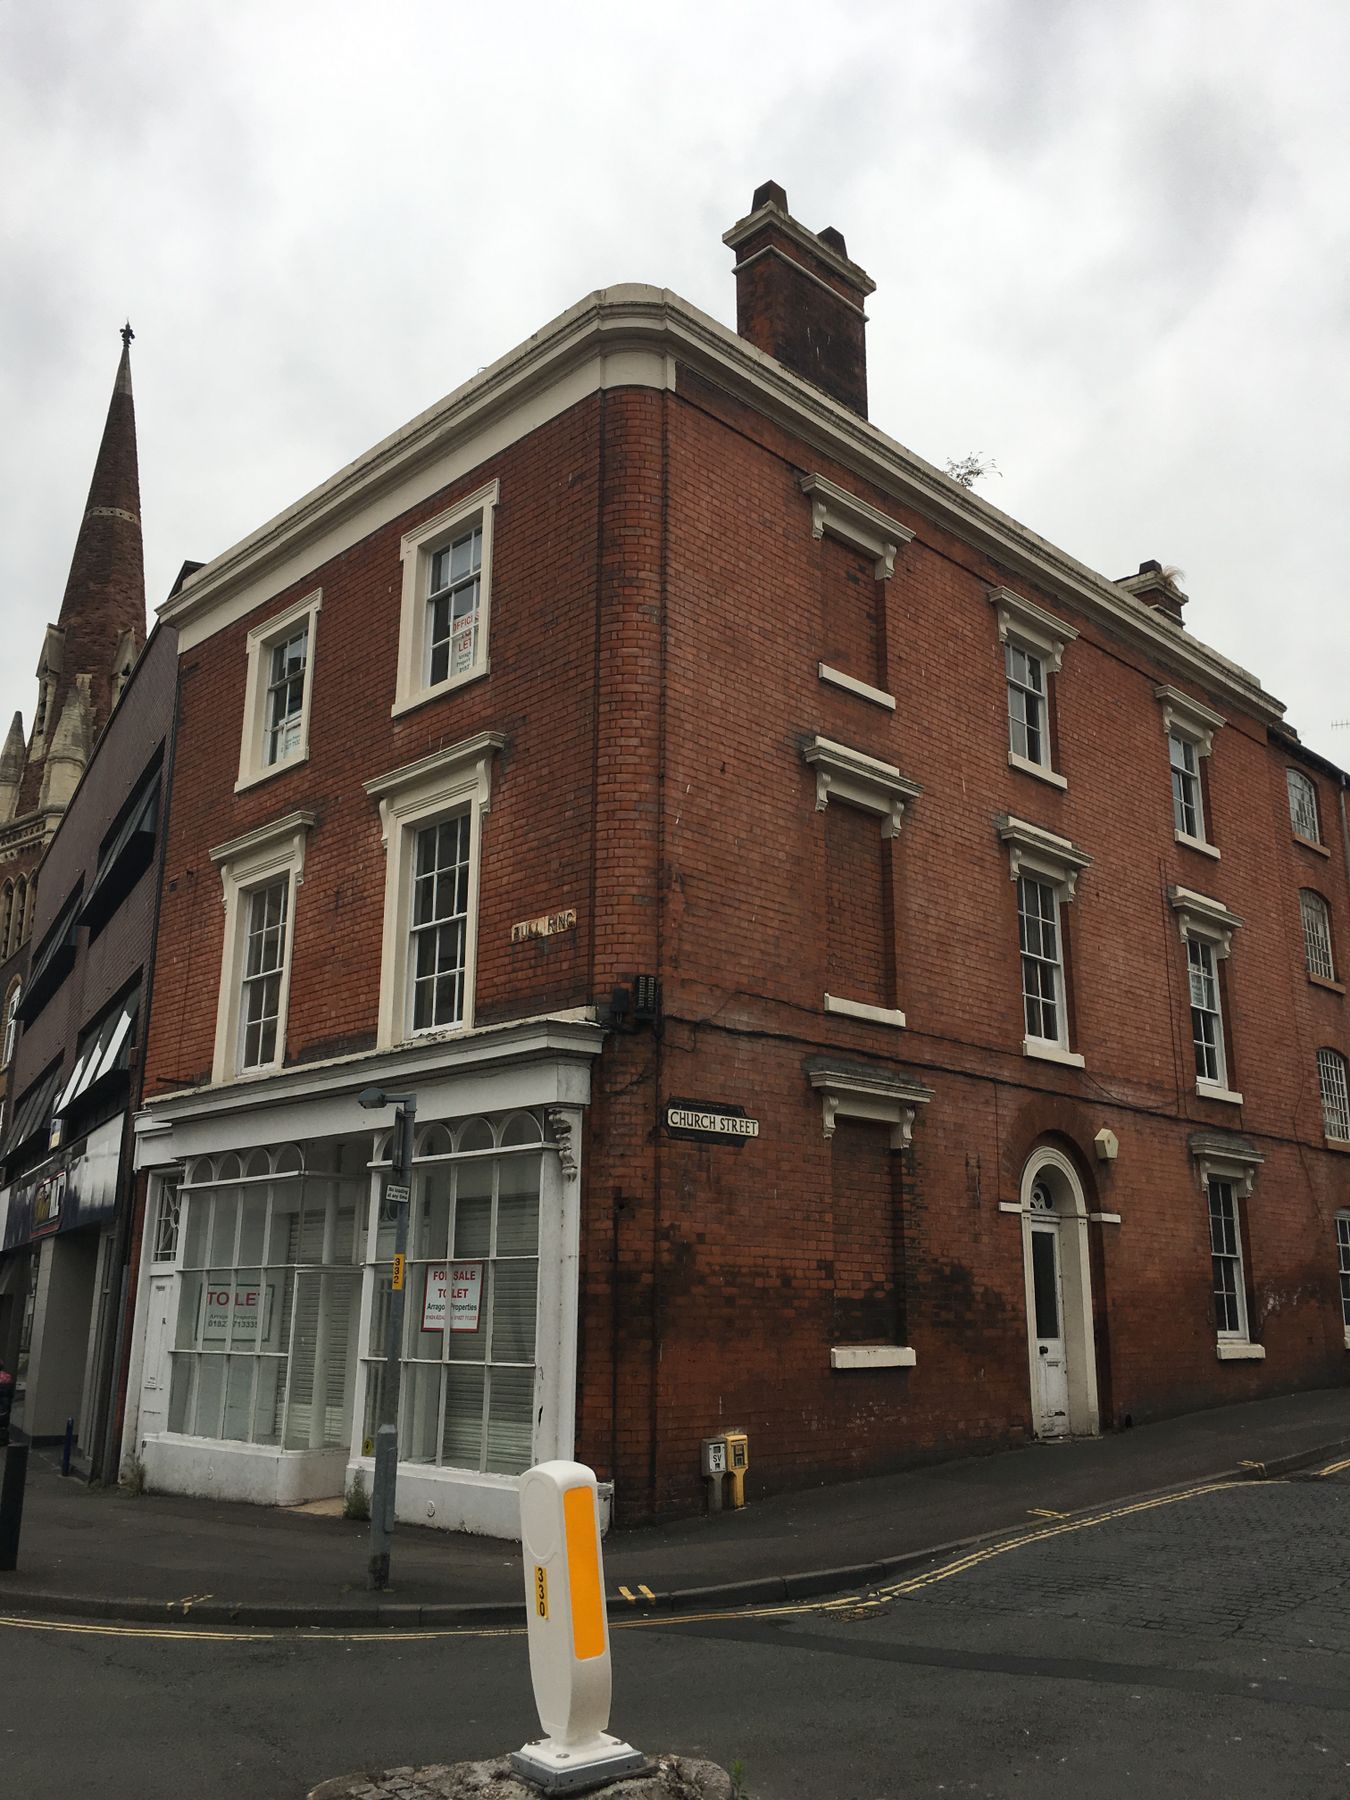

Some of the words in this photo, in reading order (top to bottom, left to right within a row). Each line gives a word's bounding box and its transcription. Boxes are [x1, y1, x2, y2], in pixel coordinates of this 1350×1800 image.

[670, 1111, 716, 1130] CHURCH
[720, 1117, 757, 1135] STREET
[393, 1257, 401, 1284] 332
[453, 1271, 476, 1281] SALE
[207, 1291, 230, 1306] TO
[235, 1292, 261, 1307] LE
[427, 1302, 445, 1312] Arrago
[712, 1454, 722, 1463] SV
[537, 1567, 546, 1617] 330
